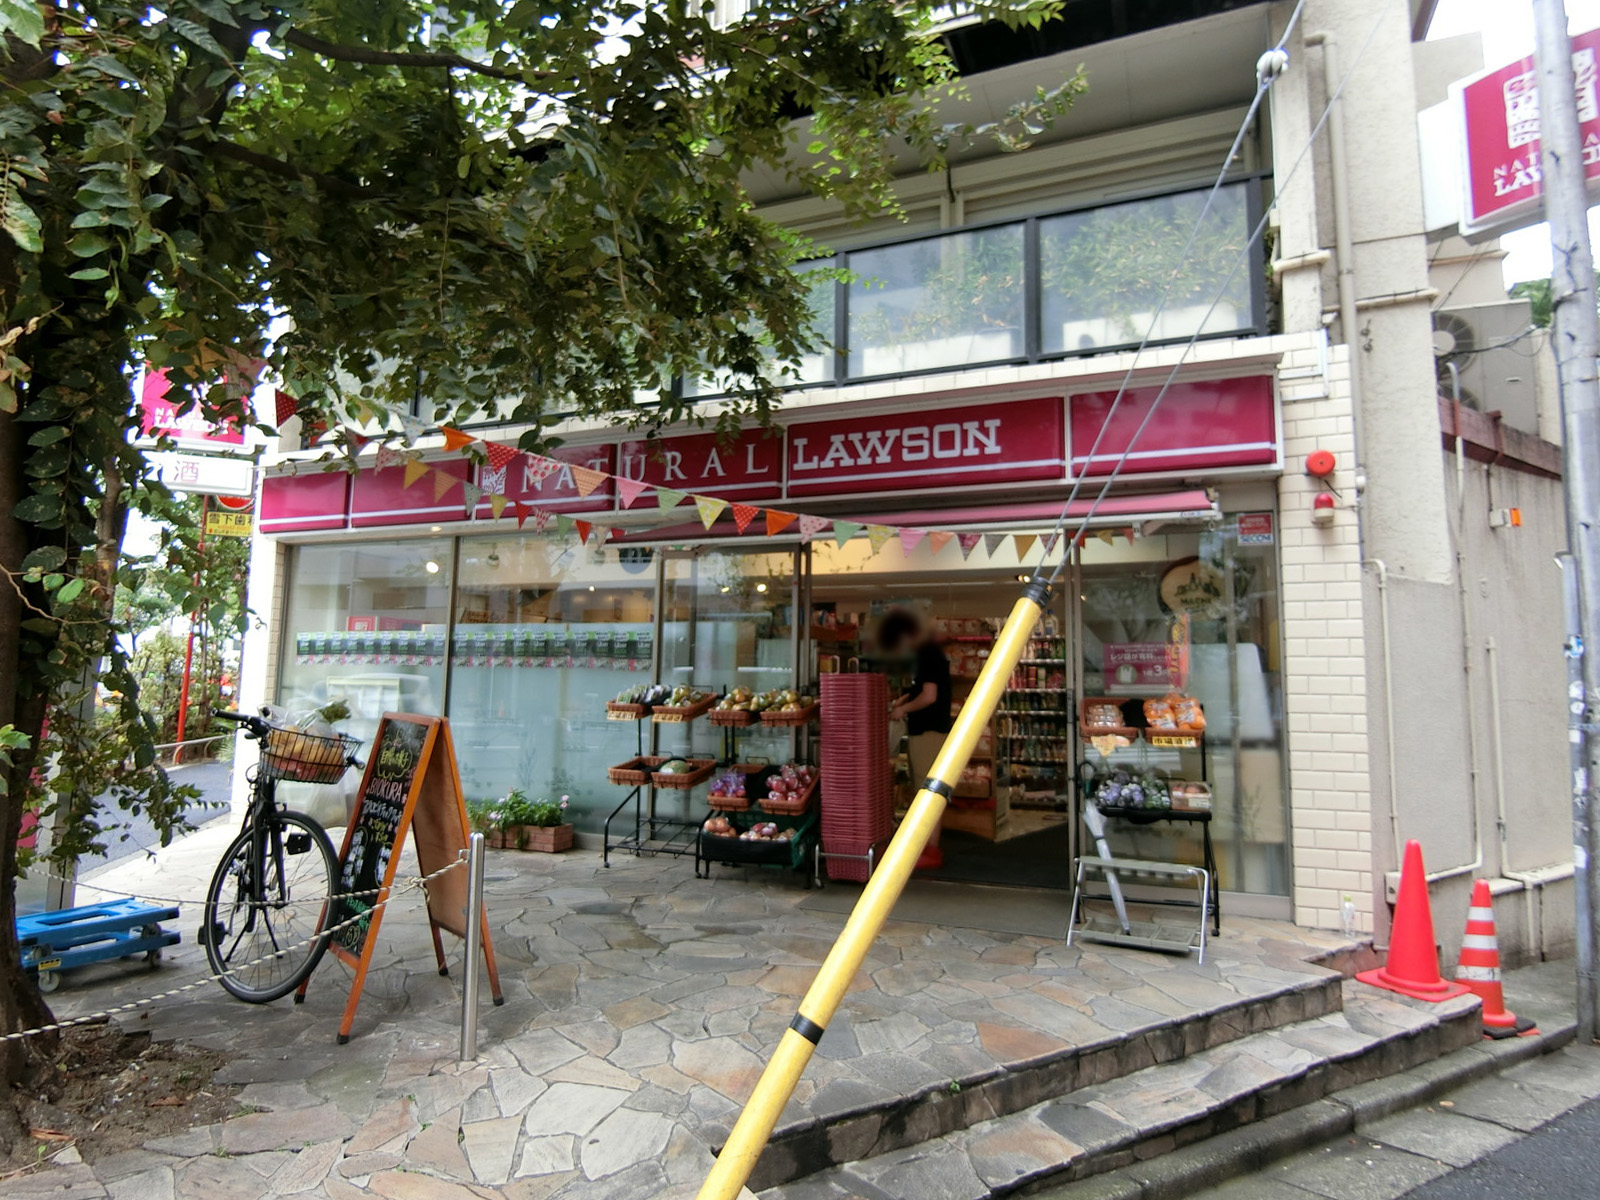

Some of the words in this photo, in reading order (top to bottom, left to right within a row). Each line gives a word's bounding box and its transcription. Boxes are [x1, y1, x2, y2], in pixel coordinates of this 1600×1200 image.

[174, 461, 200, 484] 酒
[521, 443, 769, 493] NATURAL
[793, 419, 1002, 471] LAWSON
